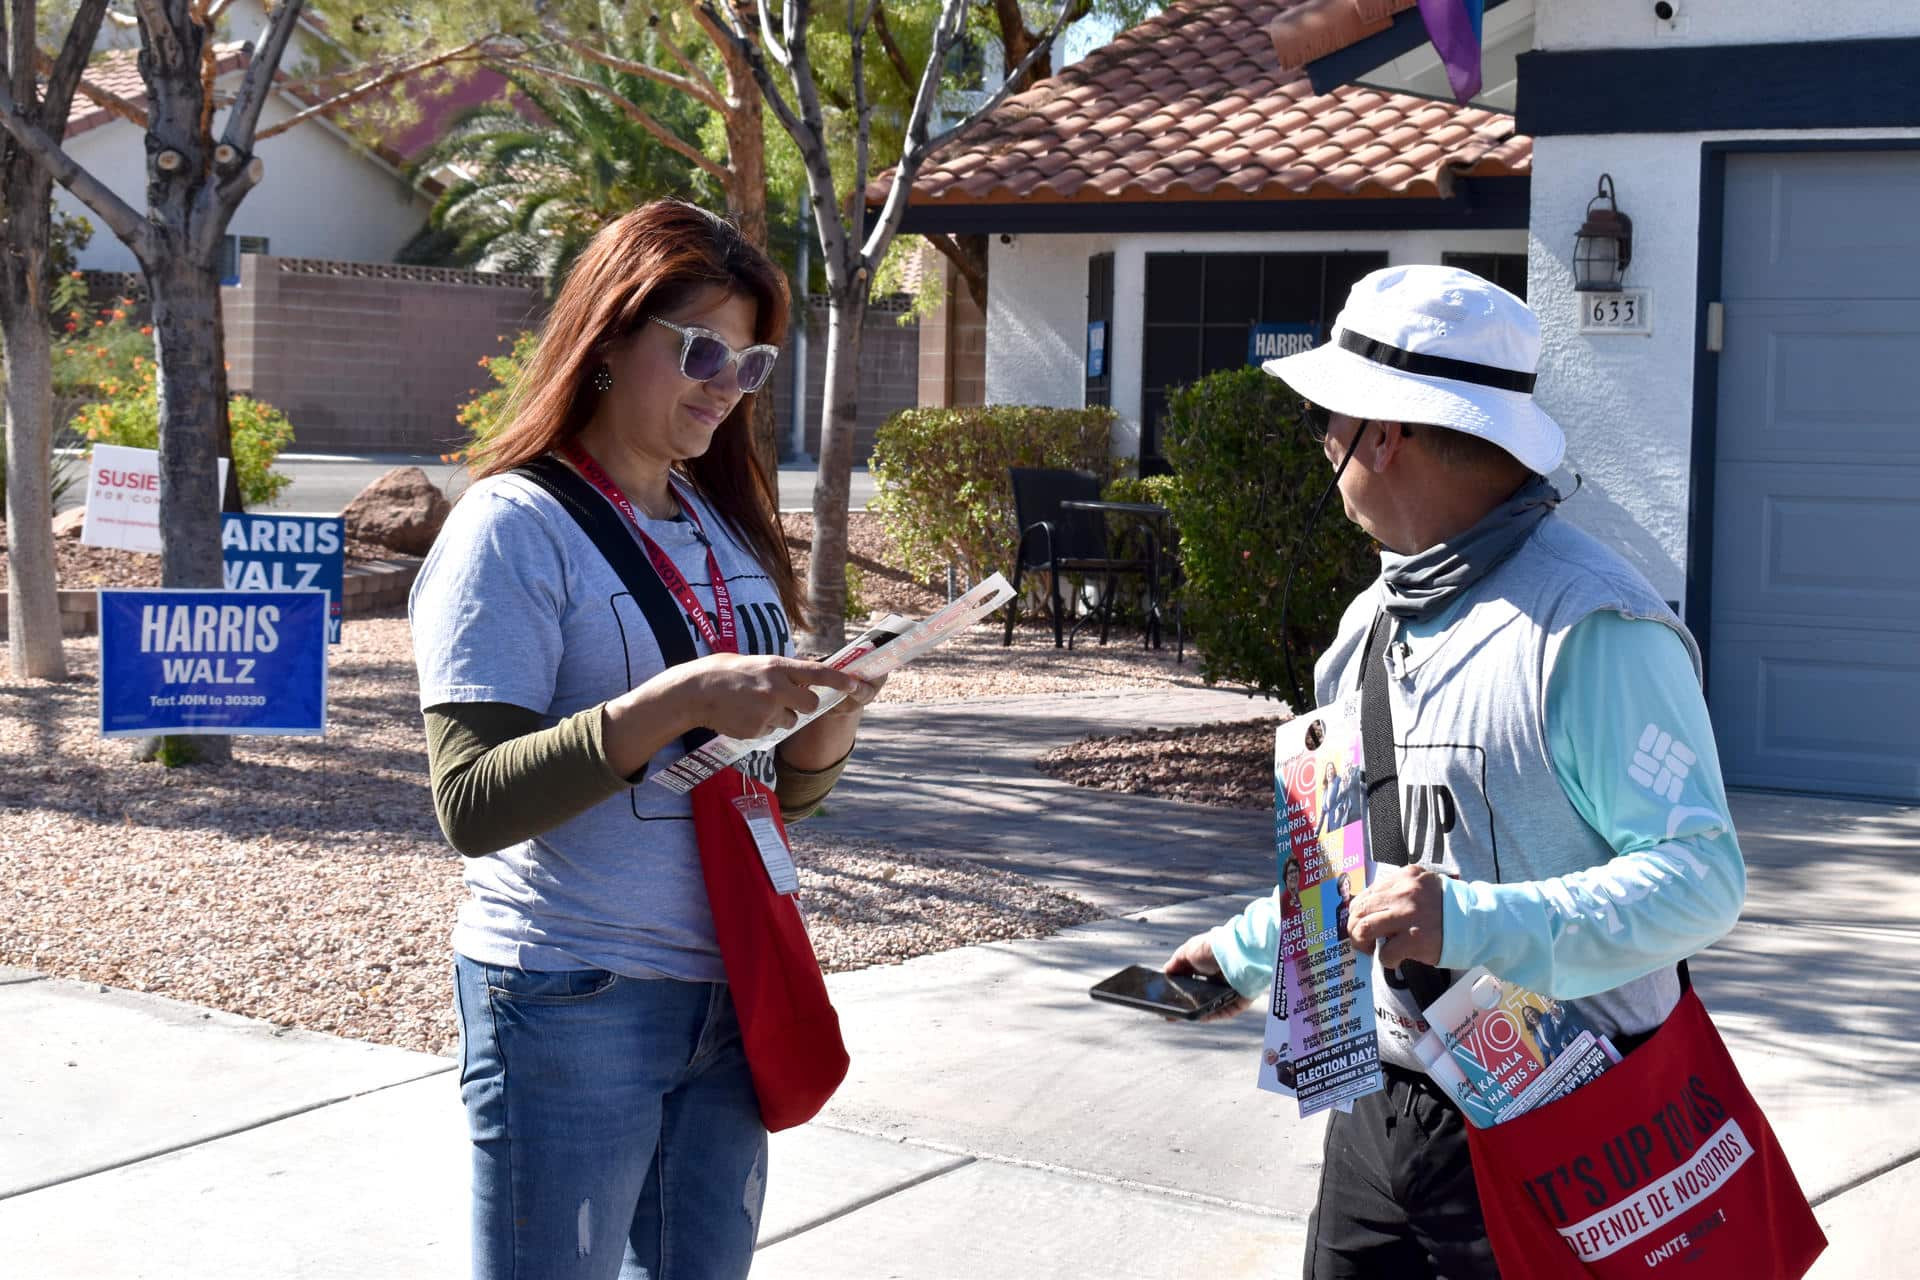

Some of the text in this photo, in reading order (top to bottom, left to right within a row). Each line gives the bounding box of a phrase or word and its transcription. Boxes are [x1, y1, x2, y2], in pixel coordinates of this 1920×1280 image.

[1593, 301, 1634, 321] 633
[1255, 333, 1313, 356] HARRIS
[97, 469, 160, 491] SUSIE
[715, 585, 734, 637] IT'S UP TO US
[141, 605, 280, 652] HARRIS
[163, 659, 256, 684] WALZ
[150, 695, 266, 706] Text JOIN to 30330
[1277, 797, 1311, 820] KAMALA
[1277, 811, 1316, 837] HARRIS &
[1404, 784, 1456, 864] UP
[1277, 827, 1319, 854] TIM WALZ
[1304, 867, 1329, 885] JACKY
[1282, 908, 1316, 930] RE-ELECT
[1282, 921, 1317, 944] SUSIE LEE
[1284, 944, 1295, 957] TO
[1296, 926, 1338, 951] CONGRESS
[1295, 1057, 1313, 1070] EARLY
[1331, 1045, 1343, 1055] OCT
[1296, 1046, 1377, 1085] ELECTION DAY:
[1324, 1070, 1357, 1088] NOVEMBER
[1478, 1051, 1523, 1092] KAMALA
[1487, 1067, 1528, 1106] HARRIS
[1526, 1060, 1540, 1072] &
[1523, 1075, 1726, 1227] IT'S UP TO US
[1563, 1132, 1742, 1258] DEPENDE DE NOSOTROS
